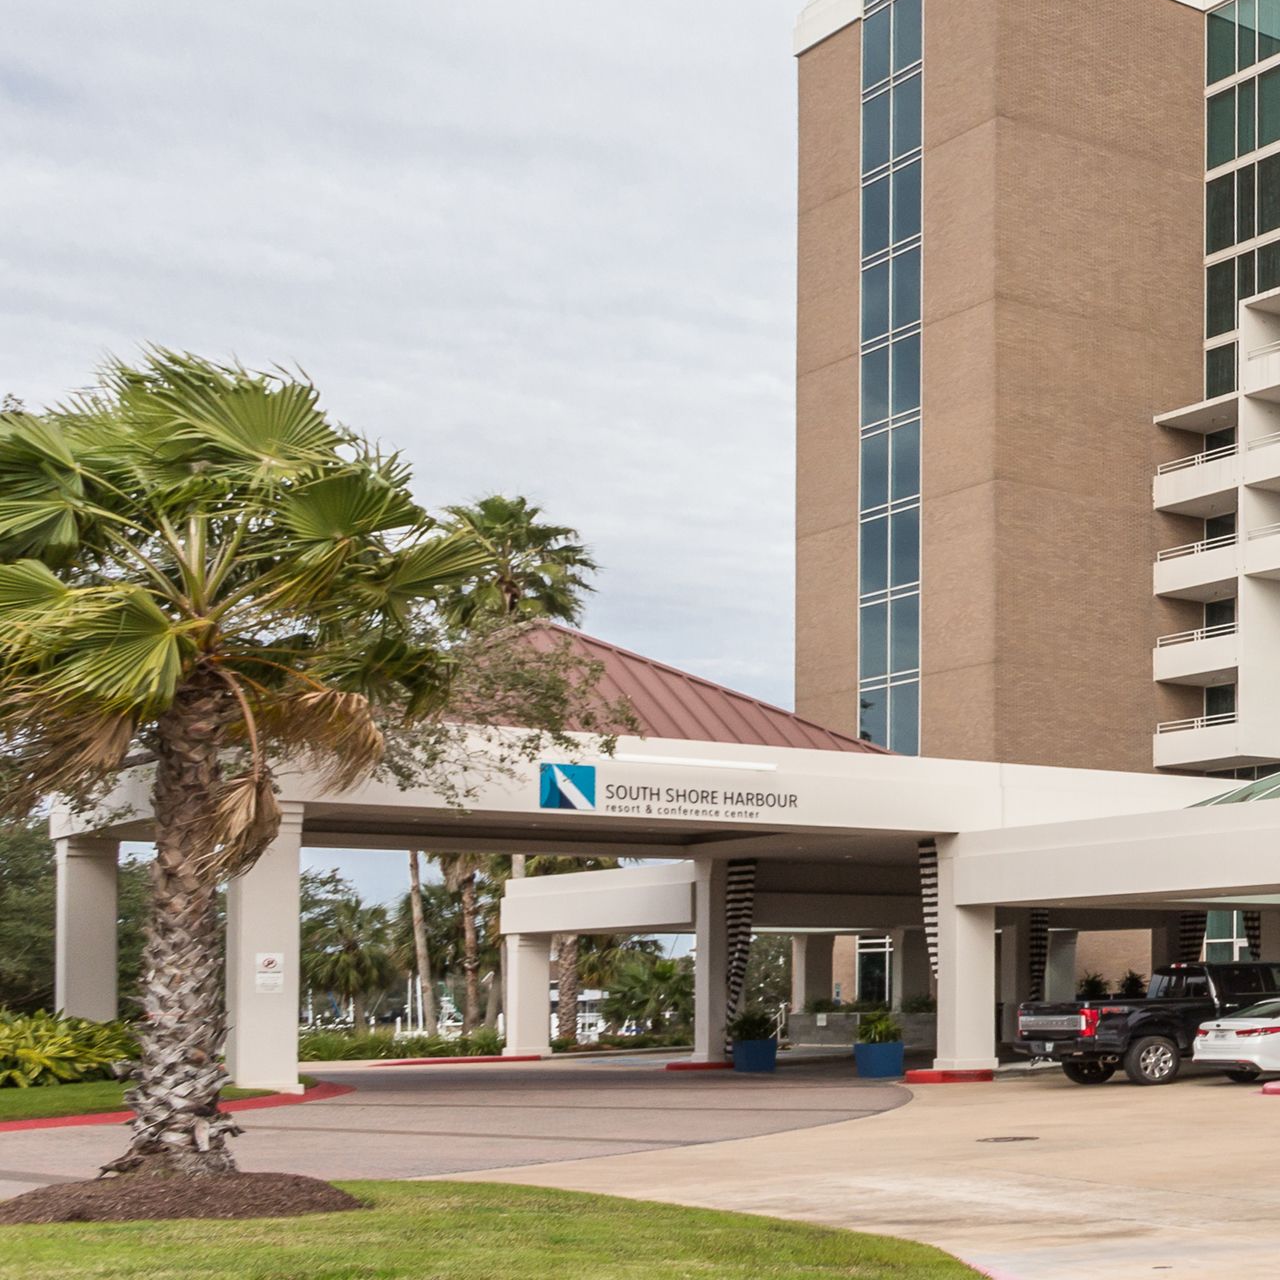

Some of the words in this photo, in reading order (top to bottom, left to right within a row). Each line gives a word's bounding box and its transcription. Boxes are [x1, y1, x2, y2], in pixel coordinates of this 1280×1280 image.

[605, 784, 660, 802] SOUTH
[665, 788, 719, 805] SHORE
[723, 791, 798, 808] HARBOUR
[605, 804, 640, 814] resort
[645, 804, 653, 815] &
[657, 805, 720, 817] conference
[724, 809, 760, 819] center
